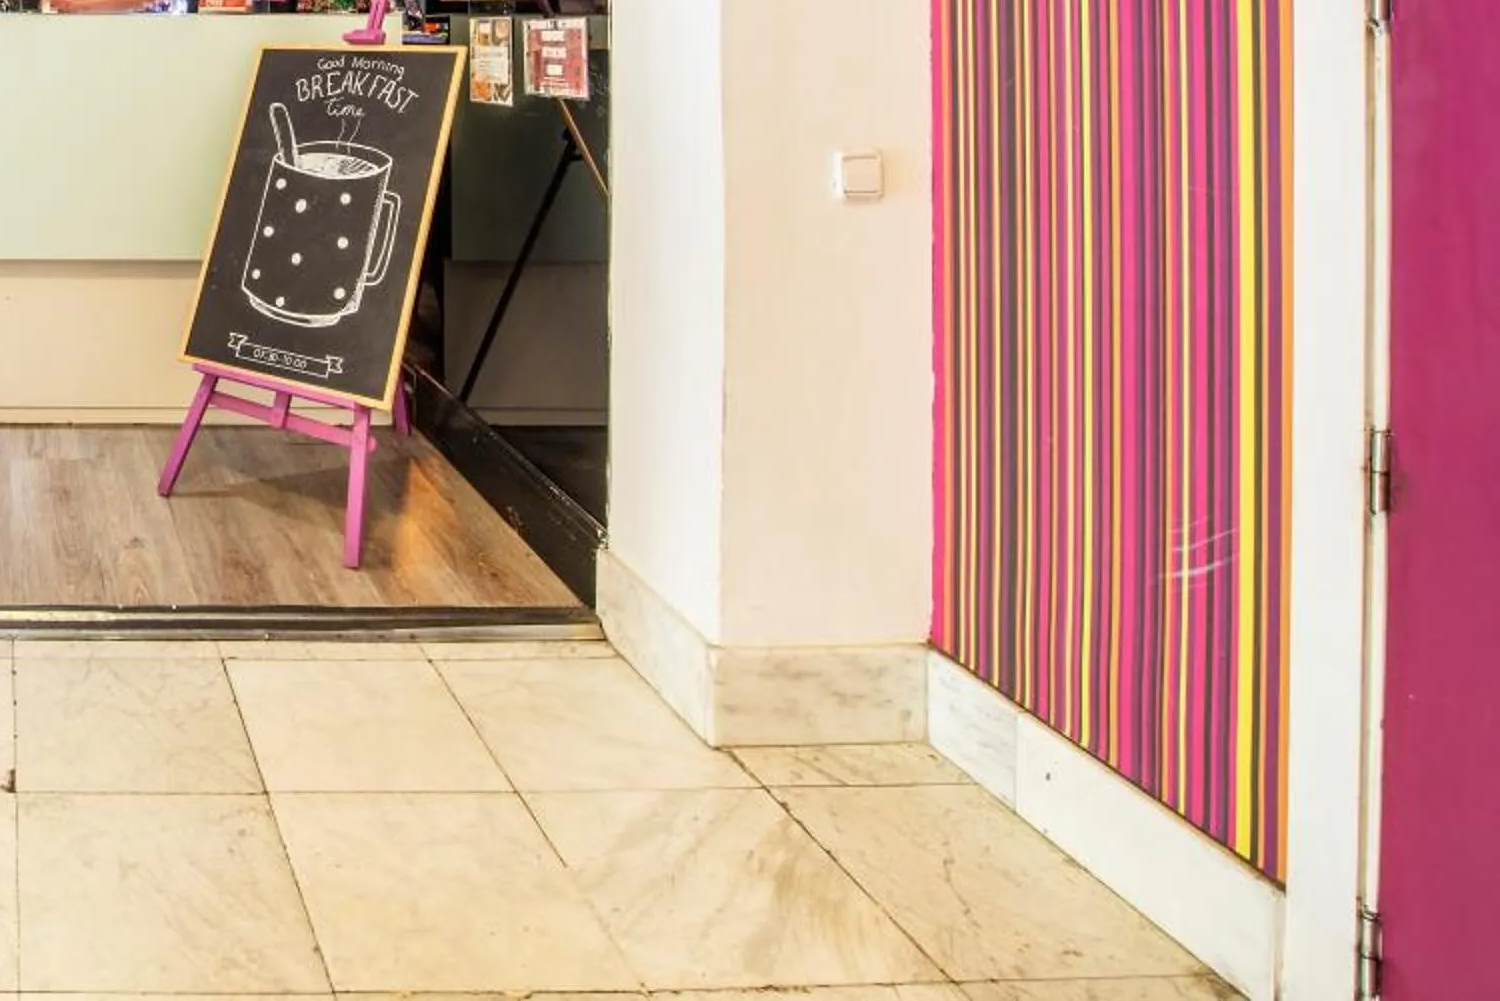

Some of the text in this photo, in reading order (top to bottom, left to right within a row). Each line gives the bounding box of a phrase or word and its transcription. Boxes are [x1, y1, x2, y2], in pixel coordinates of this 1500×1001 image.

[317, 55, 405, 82] Good Morning
[295, 70, 420, 114] BREAKFAST
